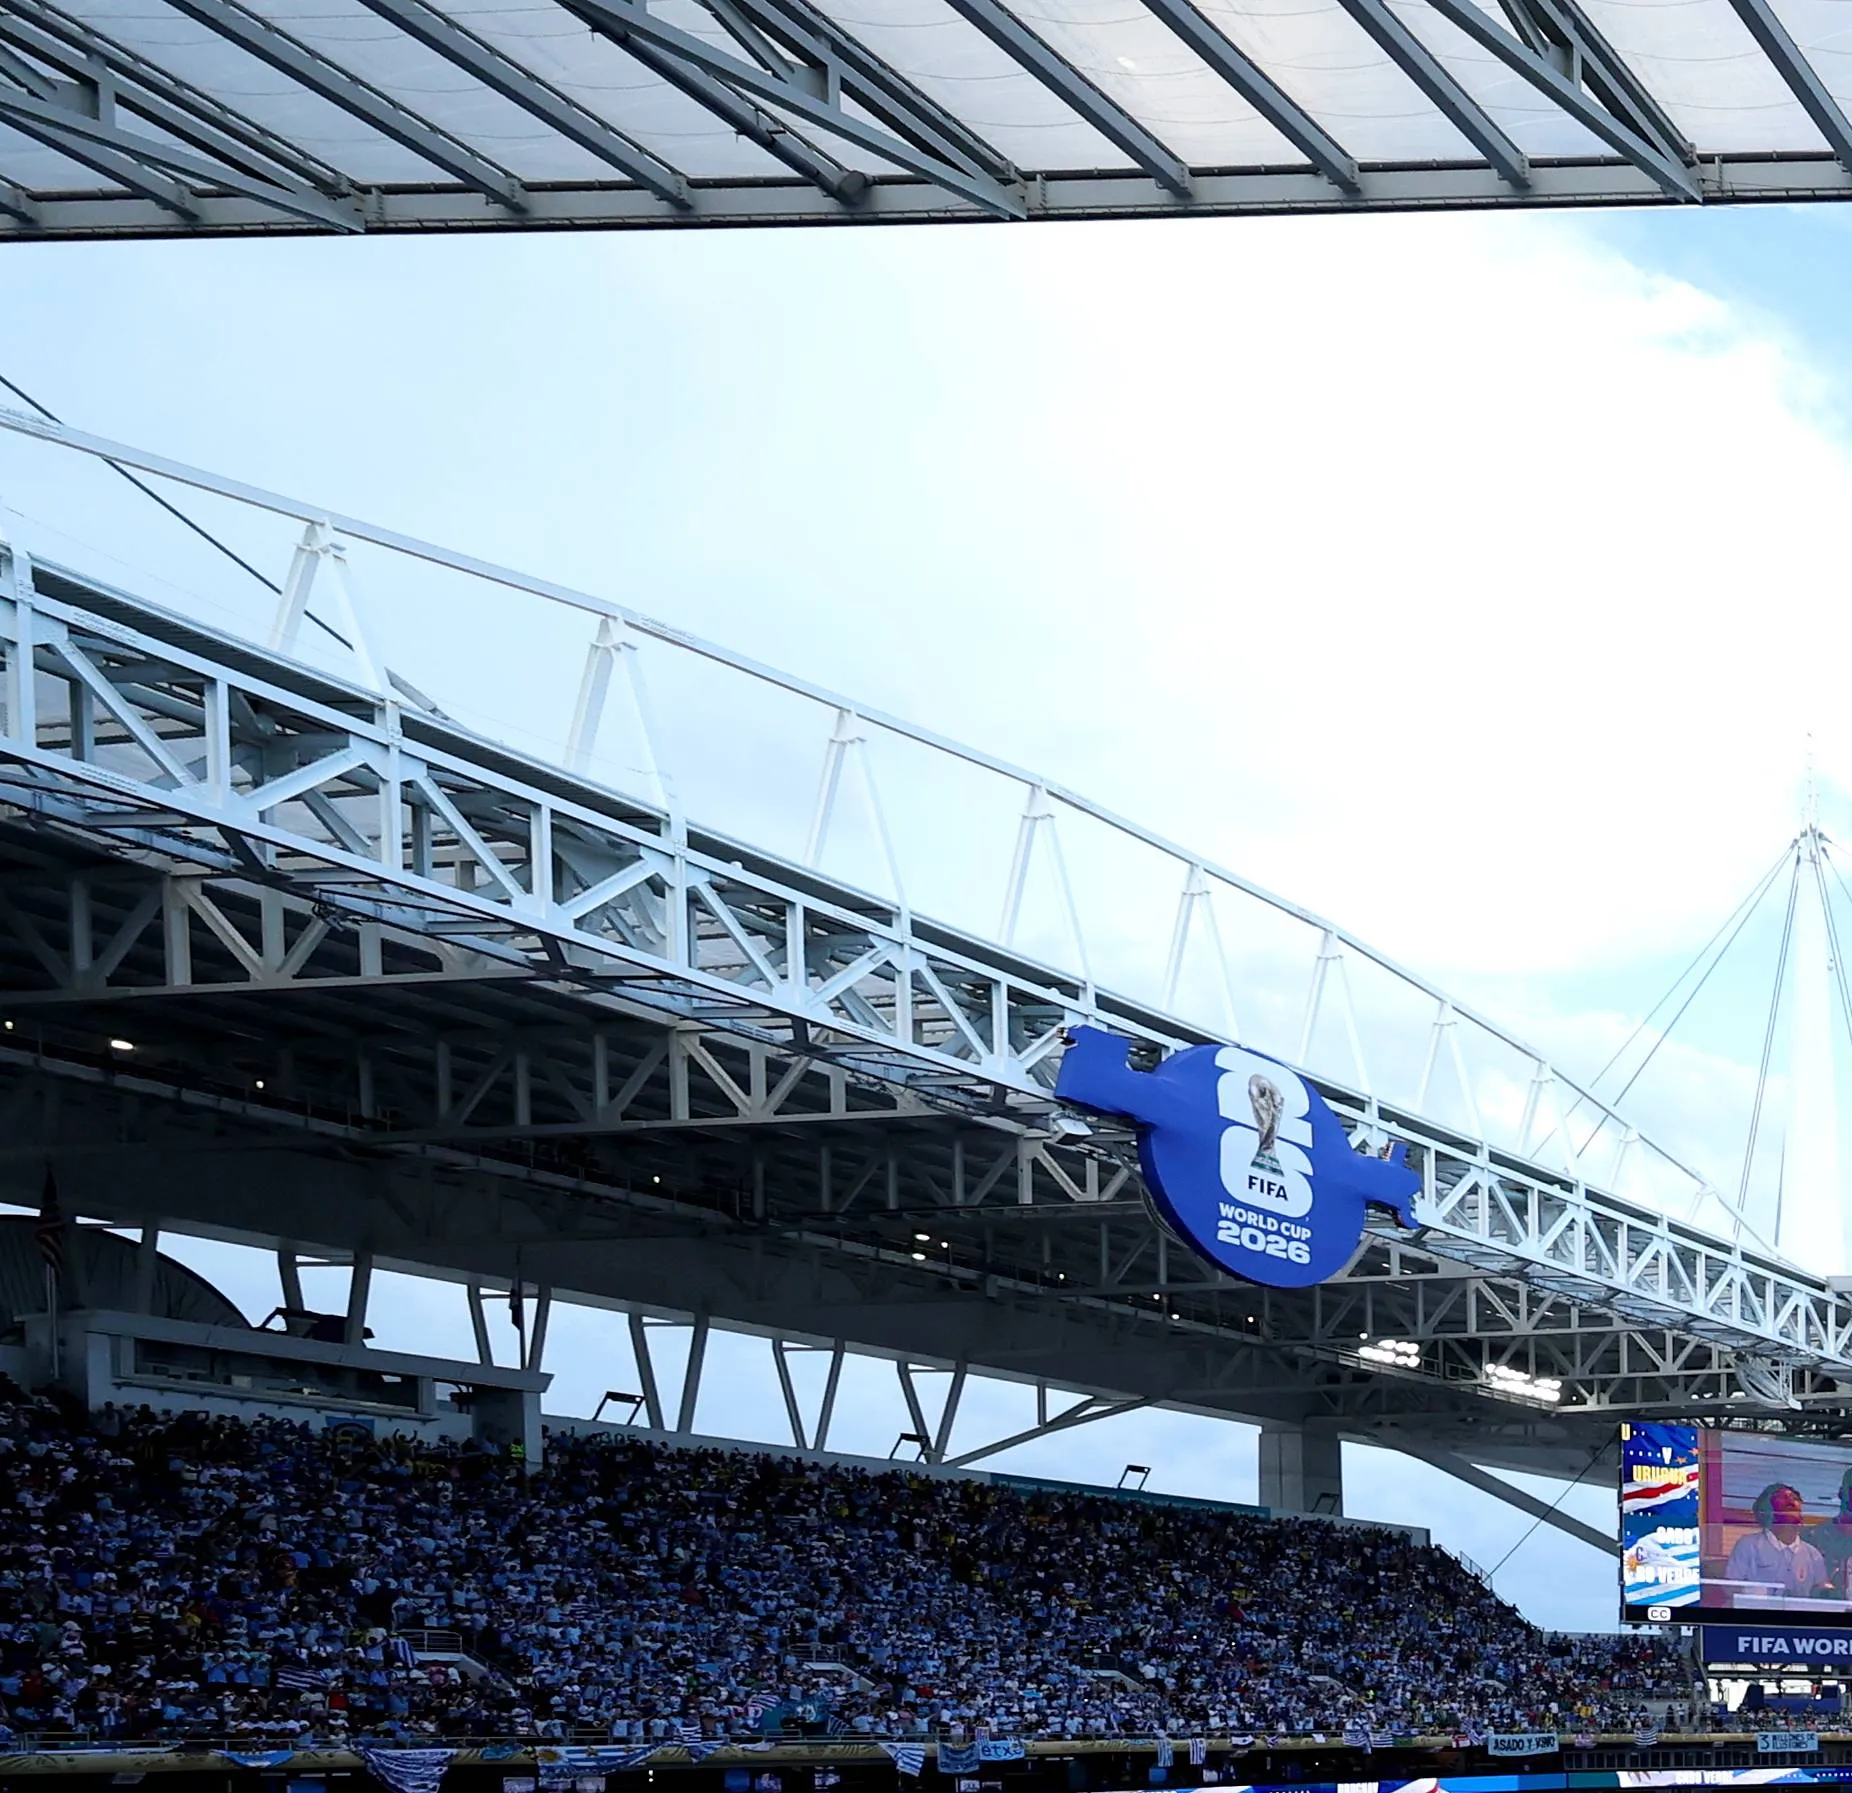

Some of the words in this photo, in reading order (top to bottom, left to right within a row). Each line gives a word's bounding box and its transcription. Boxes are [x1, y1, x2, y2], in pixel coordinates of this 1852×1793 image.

[1248, 1175, 1288, 1201] FIFA
[1218, 1202, 1279, 1232] WORLD
[1281, 1221, 1311, 1240] CUP
[1217, 1220, 1310, 1265] 2026
[1651, 1609, 1668, 1619] CC
[1738, 1636, 1790, 1654] FIFA
[1494, 1739, 1524, 1751] ASADO
